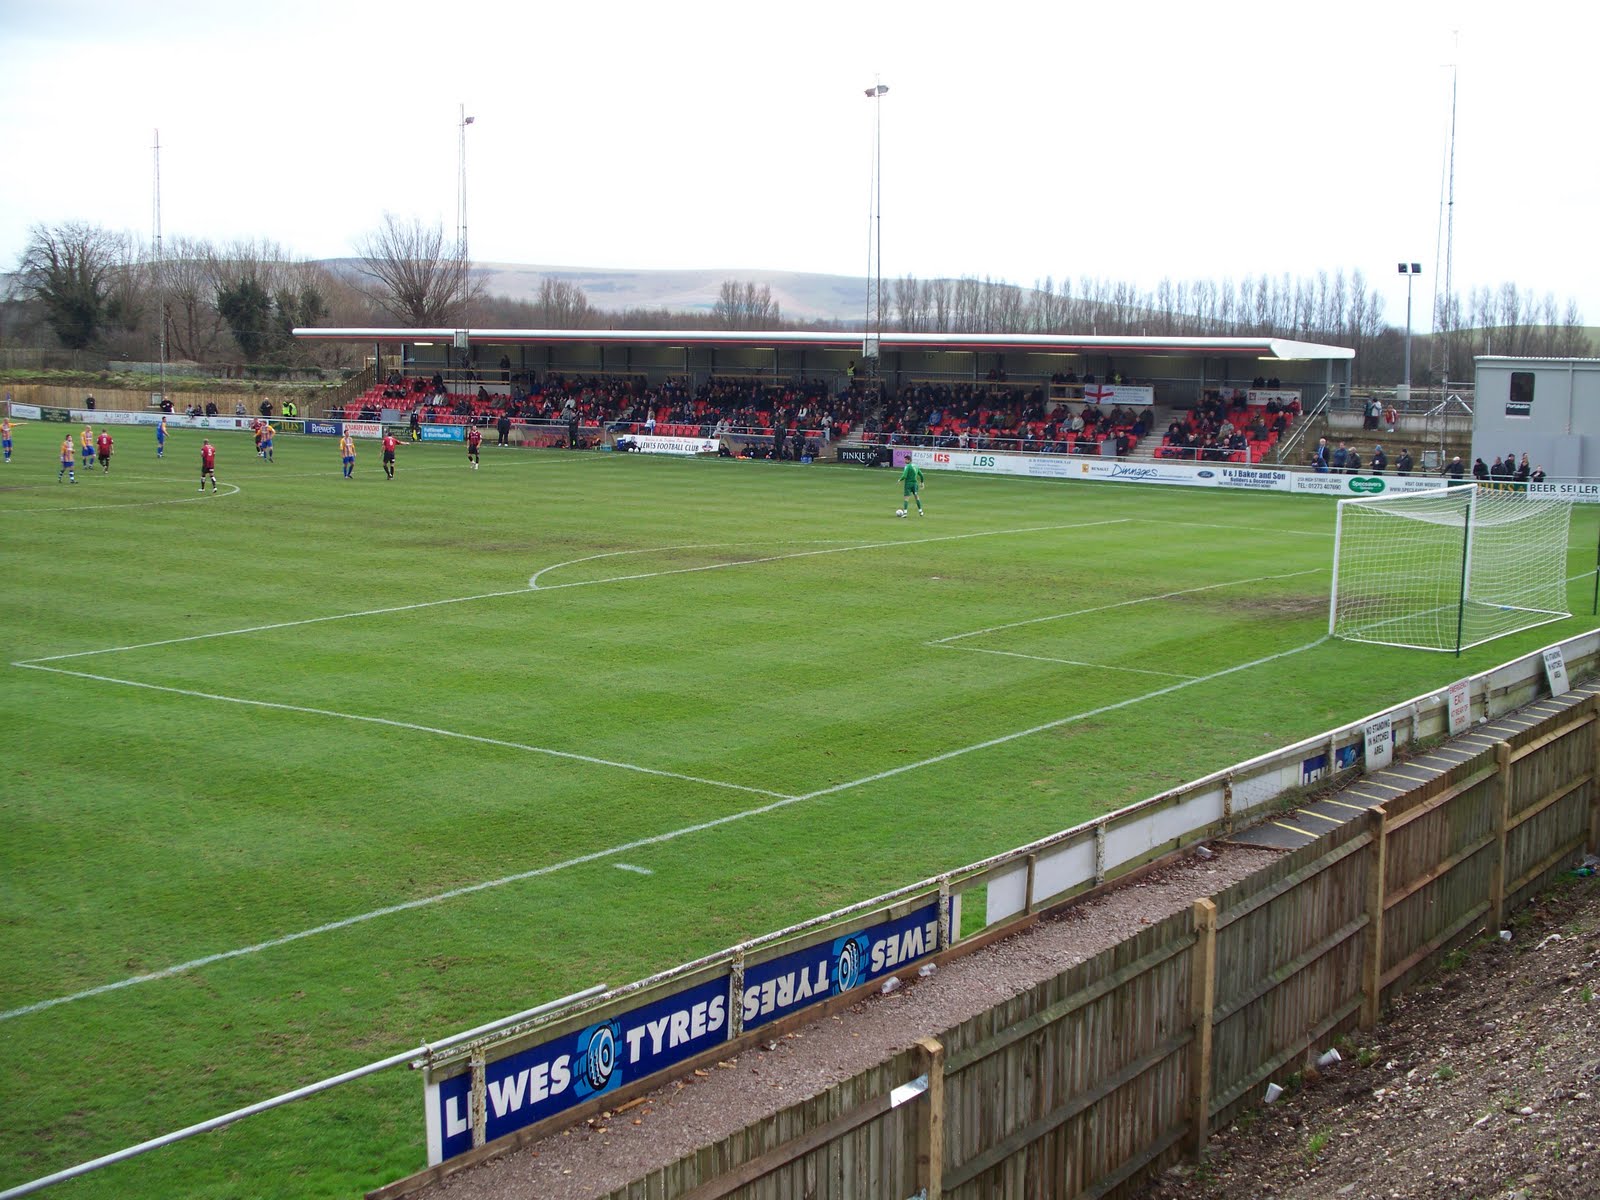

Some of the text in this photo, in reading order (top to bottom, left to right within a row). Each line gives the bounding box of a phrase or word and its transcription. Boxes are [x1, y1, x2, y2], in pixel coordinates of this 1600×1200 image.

[281, 421, 299, 432] TILES
[311, 423, 336, 434] Brewers
[640, 441, 699, 452] LEWES FOOTBALL CLUB
[842, 451, 865, 460] PINKIE
[934, 453, 950, 463] ICS
[972, 455, 995, 467] LBS
[1222, 469, 1228, 477] V
[1238, 470, 1258, 479] Baker
[1258, 471, 1272, 480] and
[1272, 472, 1286, 480] Son
[1529, 483, 1557, 493] BEER
[1454, 692, 1464, 705] EXIT
[1372, 718, 1390, 733] STANDING
[1372, 731, 1389, 745] HATCHED
[1374, 744, 1384, 755] AREA
[744, 920, 938, 1021] EWES TYRES
[626, 995, 725, 1064] TYRES
